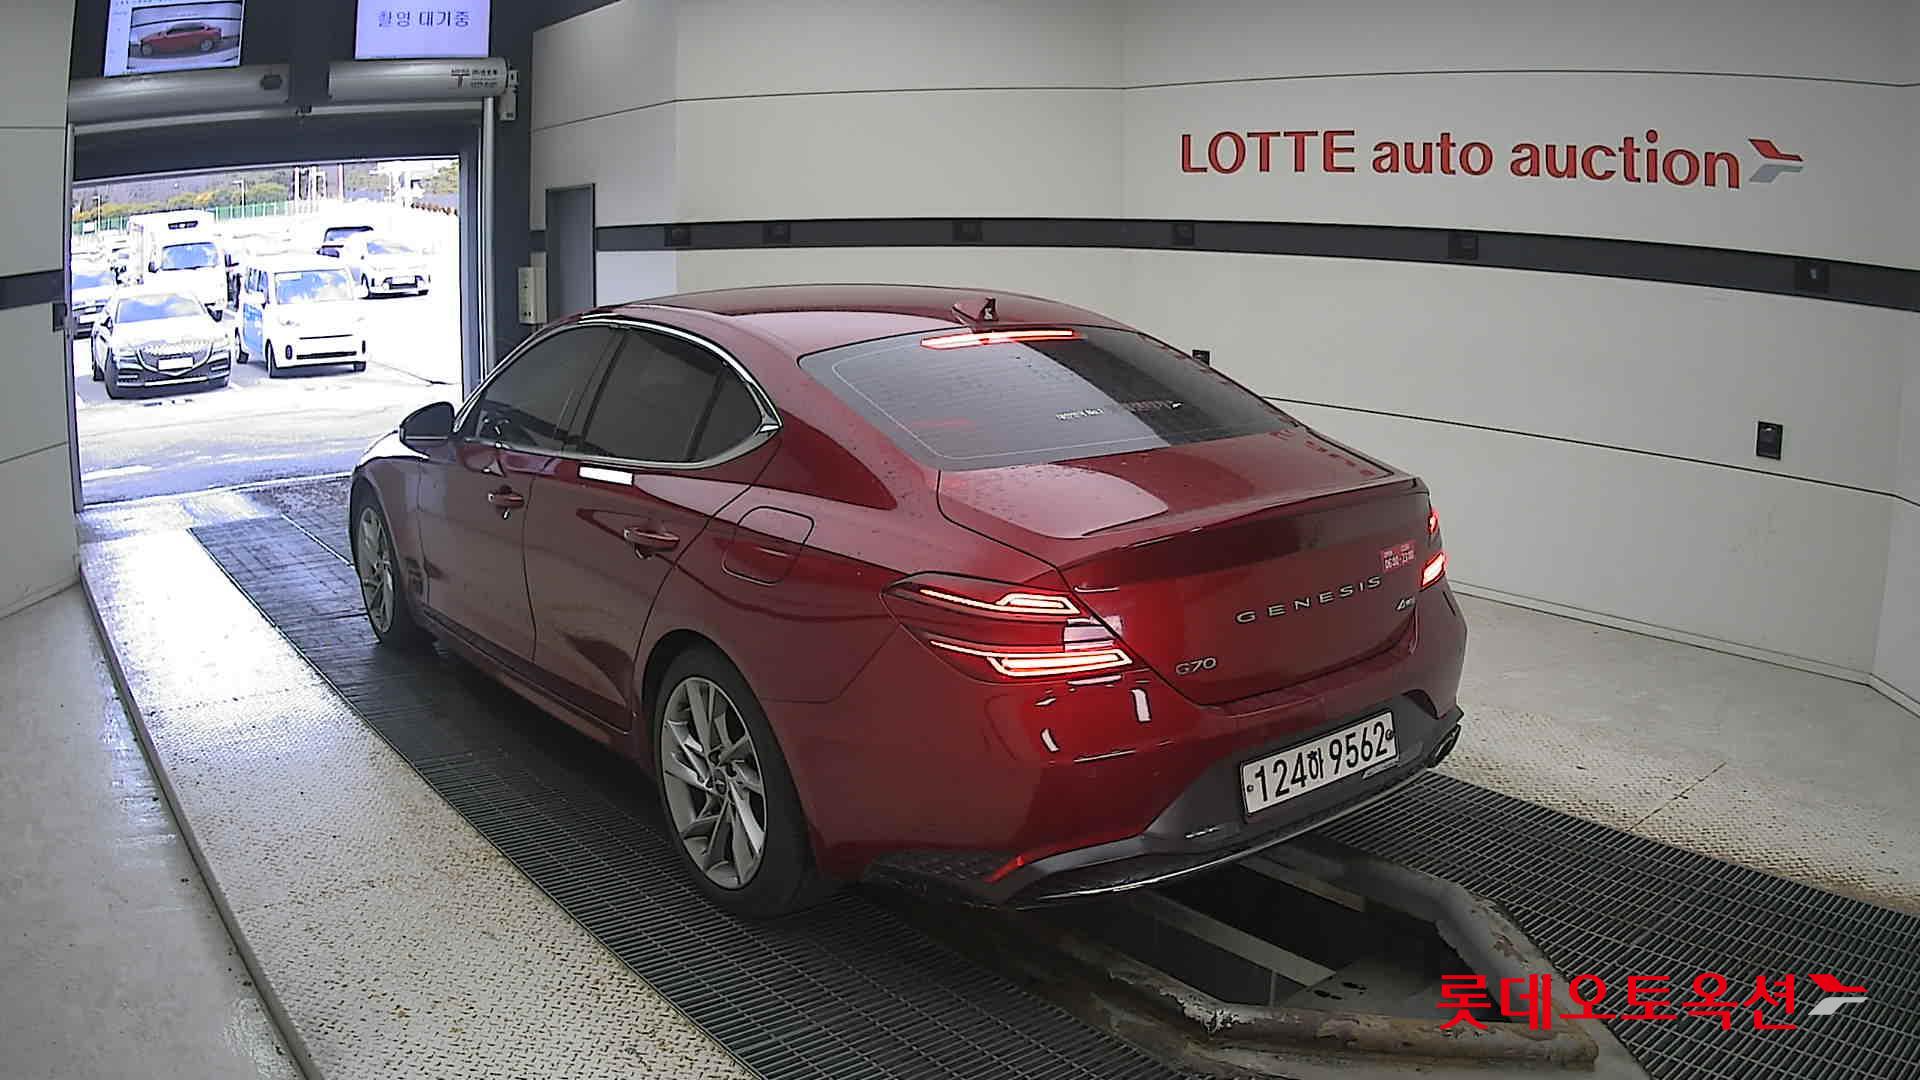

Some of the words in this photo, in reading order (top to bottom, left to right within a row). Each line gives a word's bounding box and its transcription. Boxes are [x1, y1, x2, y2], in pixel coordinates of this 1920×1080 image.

[419, 10, 471, 28] 대기중
[1180, 130, 1356, 174] LOTTE
[1371, 131, 1494, 176] auto
[1510, 129, 1741, 189] auction
[1235, 575, 1382, 625] GENESIS
[1175, 656, 1217, 676] G70
